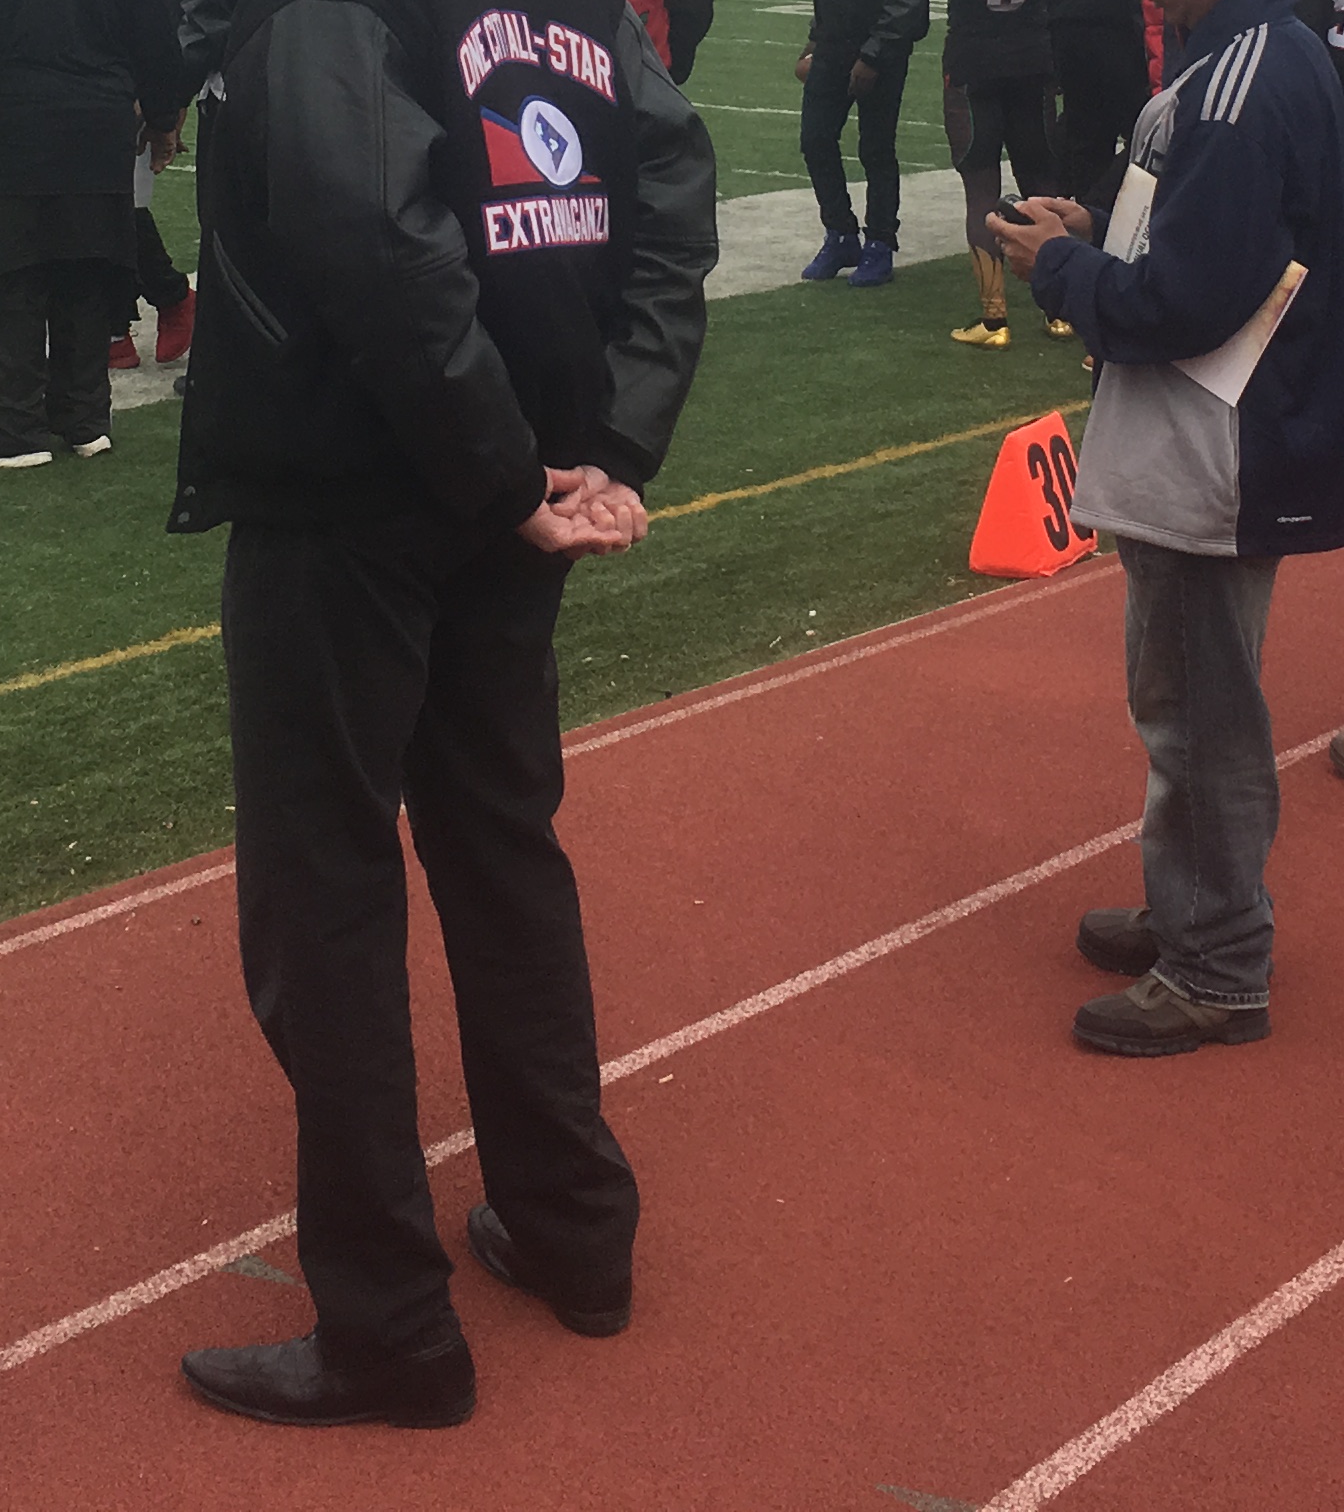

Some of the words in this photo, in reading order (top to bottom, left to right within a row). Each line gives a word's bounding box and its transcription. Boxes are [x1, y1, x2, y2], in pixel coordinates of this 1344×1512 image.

[460, 23, 492, 97] ONE
[506, 13, 615, 100] ALL-STAR
[1027, 434, 1094, 552] 30
